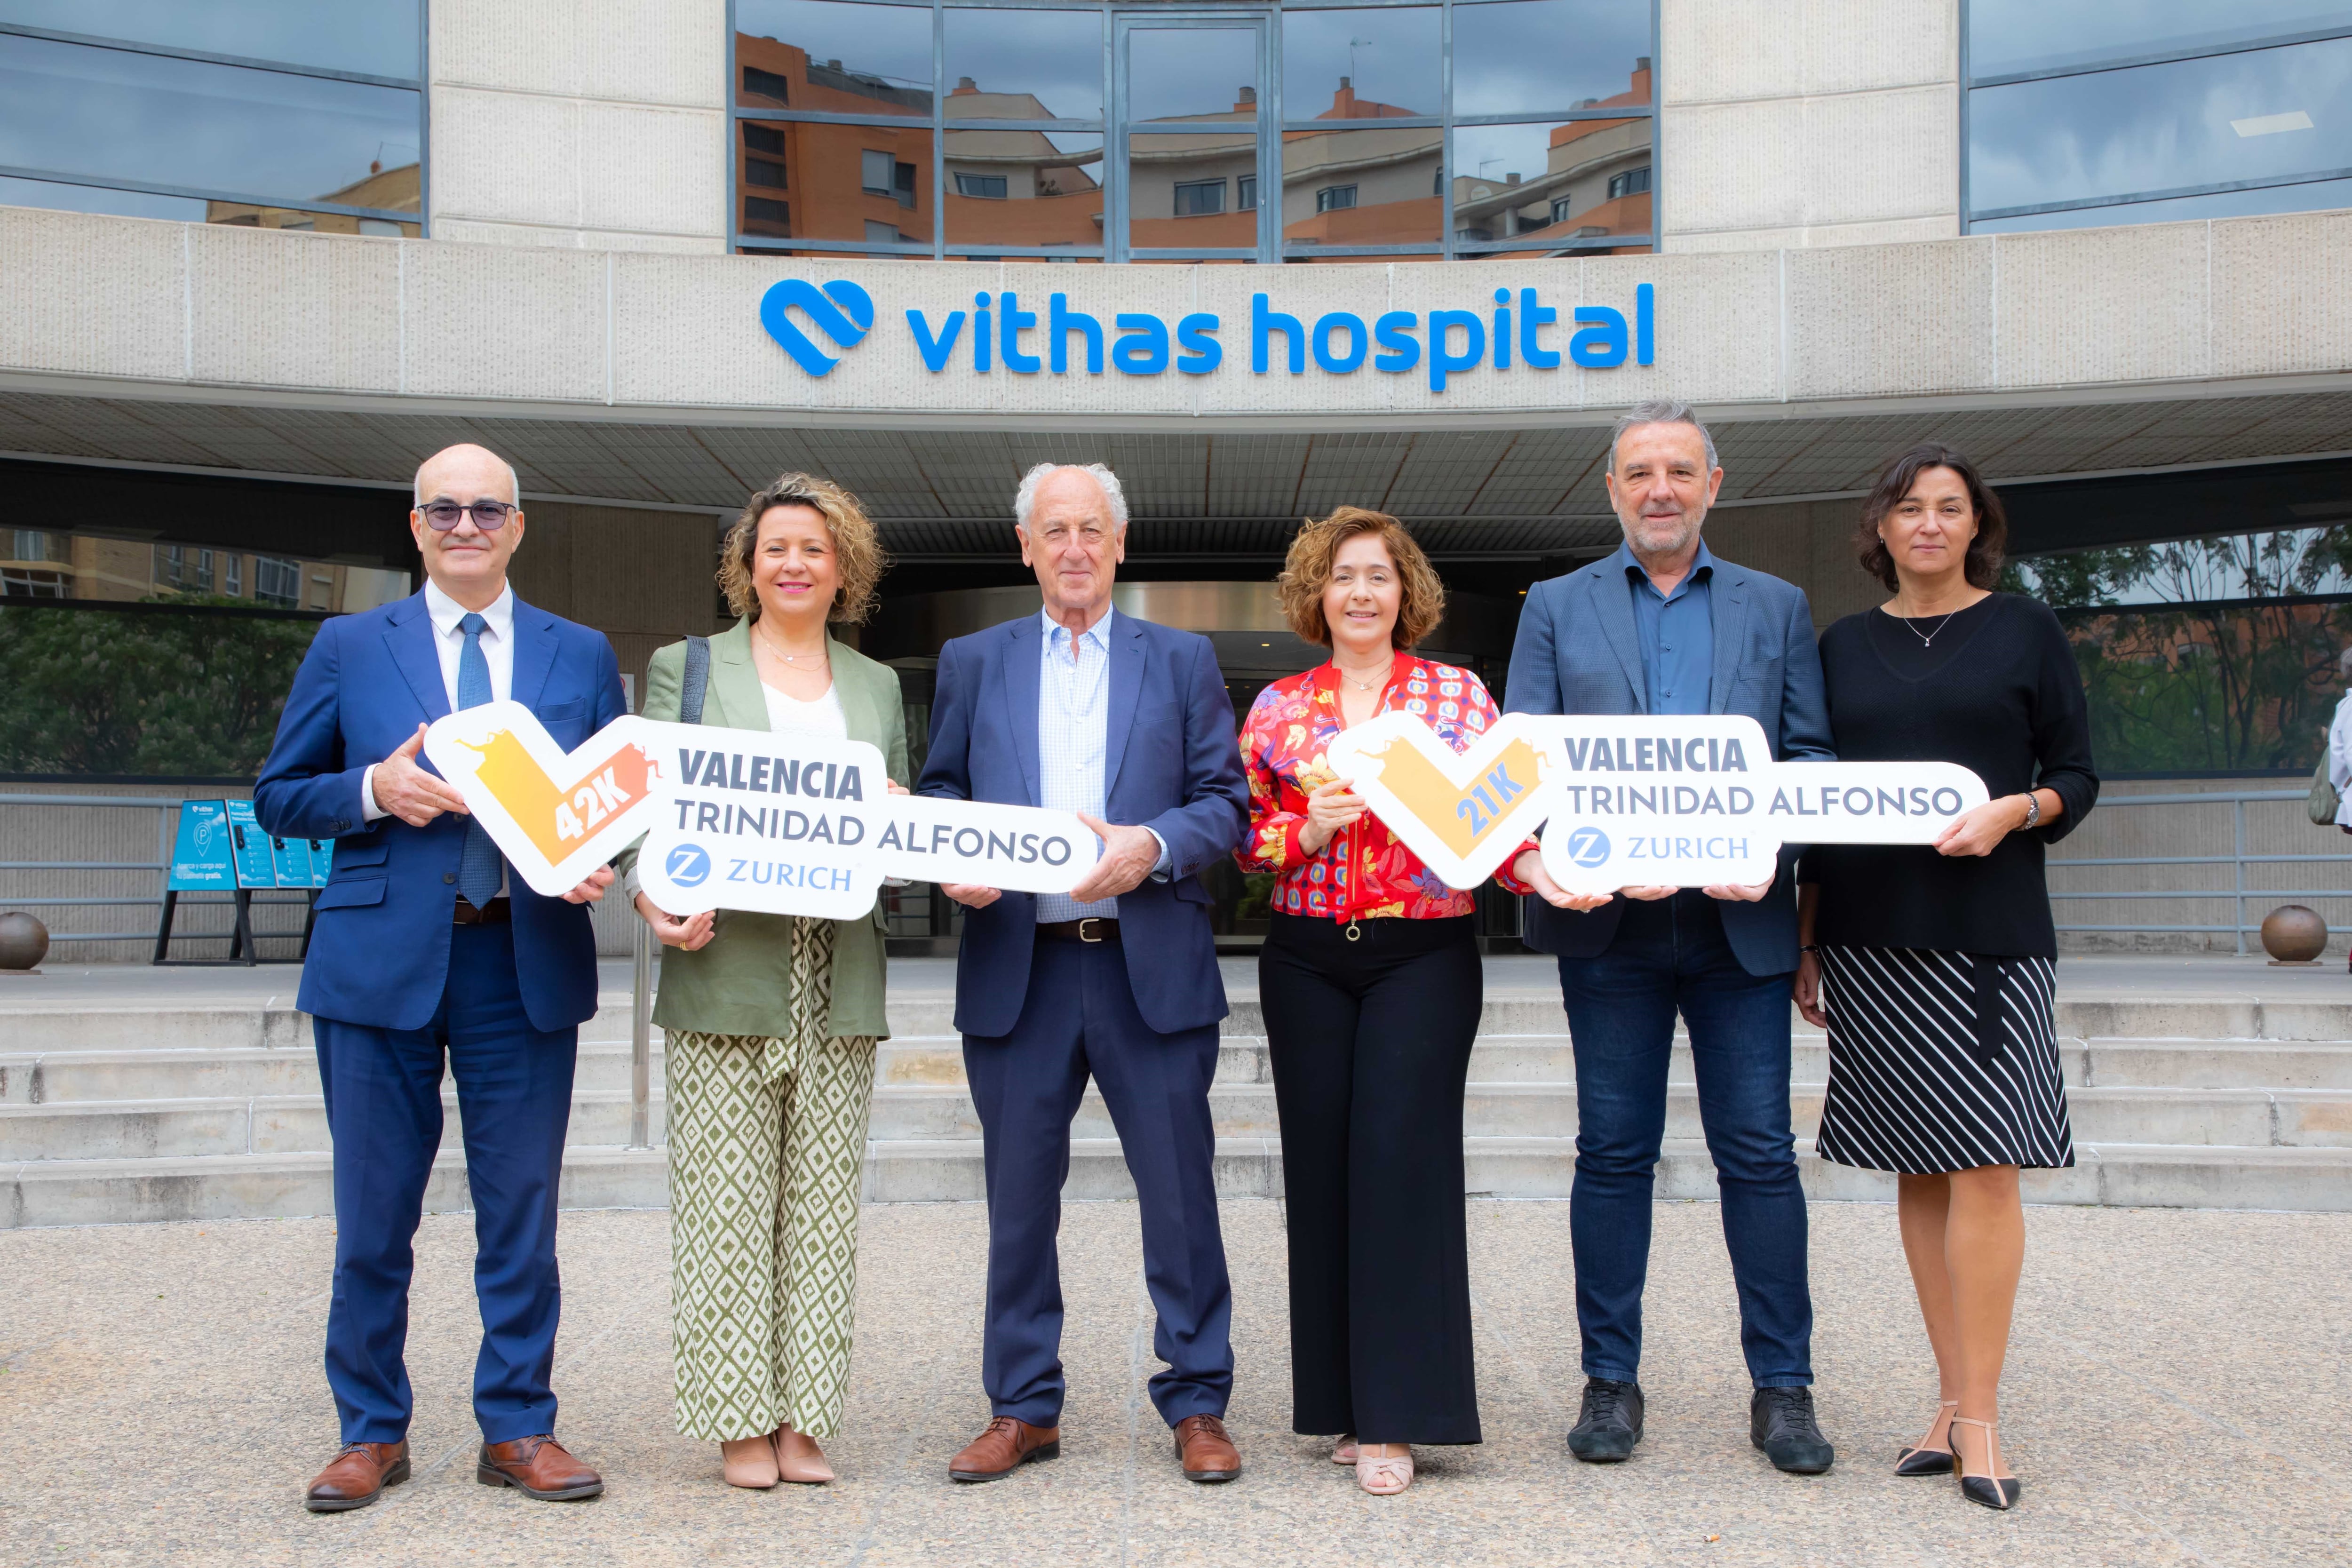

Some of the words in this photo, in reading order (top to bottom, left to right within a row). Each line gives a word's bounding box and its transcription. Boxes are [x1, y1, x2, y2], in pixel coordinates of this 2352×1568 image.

[906, 292, 1223, 374] vithas
[1252, 283, 1654, 391] hospital
[679, 748, 863, 802] VALENCIA
[1564, 738, 1748, 772] VALENCIA
[556, 766, 631, 841] 42K
[1456, 762, 1524, 838] 21K
[1567, 786, 1754, 815] TRINIDAD
[1768, 786, 1963, 816] ALFONSO
[200, 829, 207, 842] P
[674, 799, 865, 846] TRINIDAD
[877, 820, 1072, 866] ALFONSO
[1628, 837, 1749, 859] ZURICH
[726, 859, 852, 892] ZURICH
